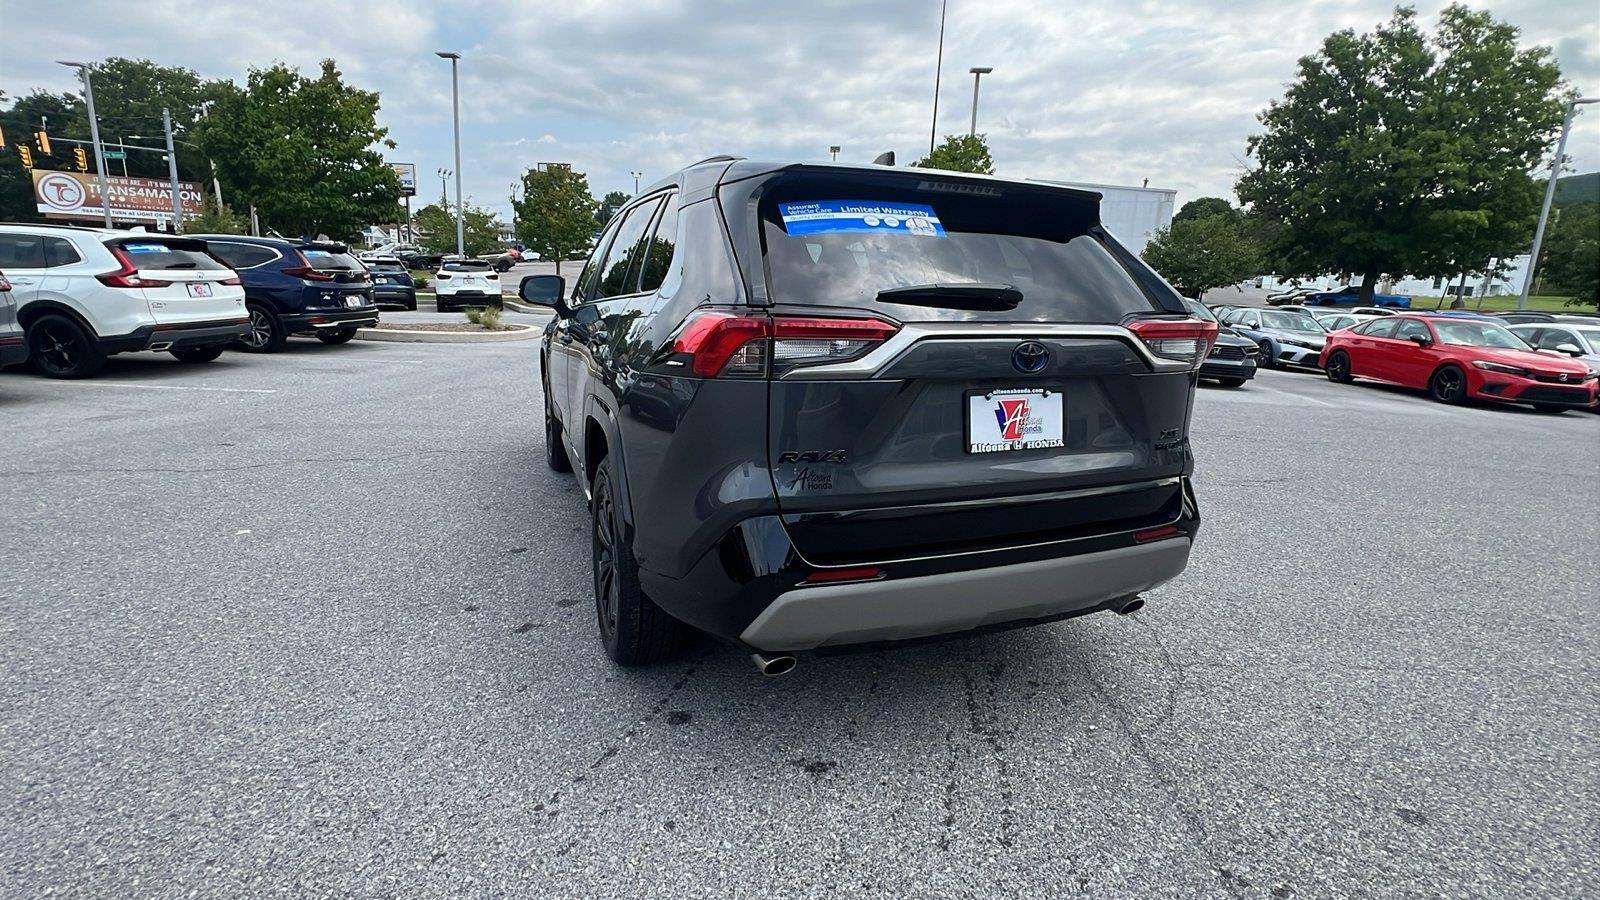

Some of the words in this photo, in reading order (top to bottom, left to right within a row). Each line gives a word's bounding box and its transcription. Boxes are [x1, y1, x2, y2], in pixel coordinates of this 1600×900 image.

[881, 207, 929, 217] Warranty
[971, 441, 1011, 453] Altoona
[1026, 437, 1065, 449] HONDA
[777, 449, 846, 464] RAV4
[807, 482, 833, 490] Honda
